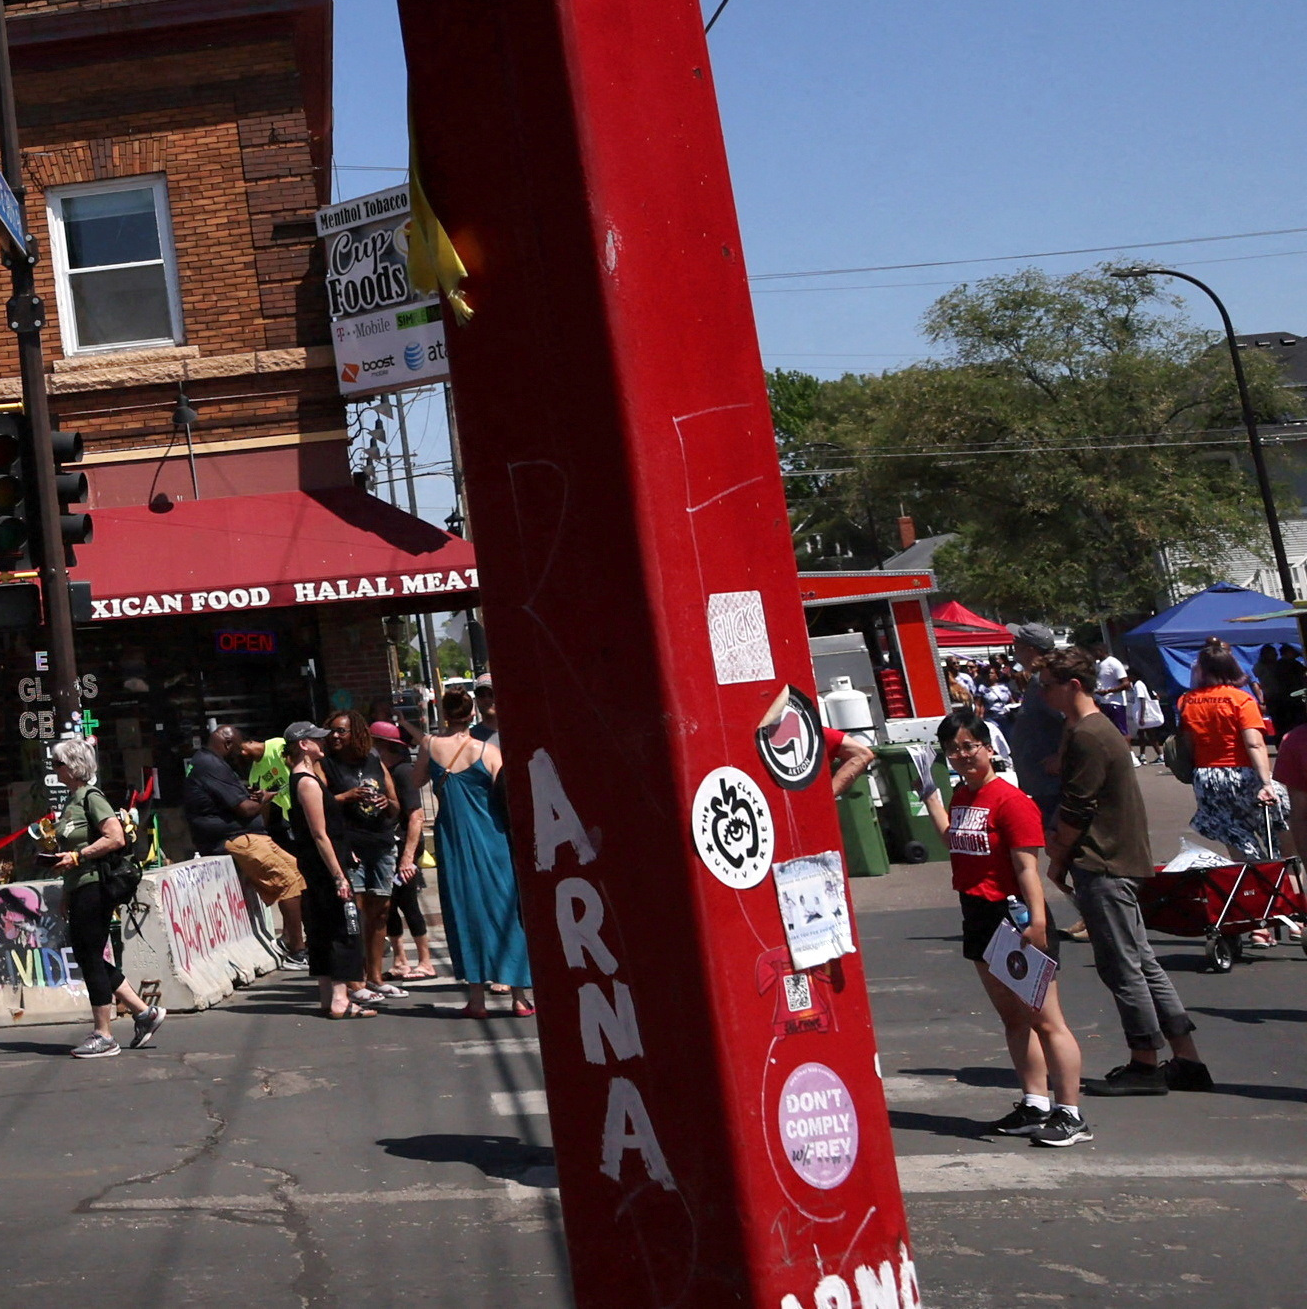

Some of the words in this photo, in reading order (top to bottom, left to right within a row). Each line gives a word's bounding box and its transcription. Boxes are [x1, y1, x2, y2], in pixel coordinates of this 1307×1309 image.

[320, 202, 362, 231] Menthol
[365, 191, 408, 218] Tobacco
[330, 227, 393, 276] Cup
[327, 263, 408, 318] Foods
[362, 354, 396, 371] boost
[91, 594, 183, 620] XICAN
[191, 586, 271, 612] FOOD
[294, 577, 394, 603] HALAL
[220, 633, 273, 651] OPEN
[788, 757, 811, 776] AKTION
[737, 781, 758, 805] CLAY
[701, 806, 710, 836] THE
[714, 825, 768, 880] UNIVERSE
[528, 747, 679, 1191] ARNA
[786, 1088, 842, 1114] DON'T
[786, 1112, 850, 1140] COMPLY
[806, 1136, 852, 1160] FREY
